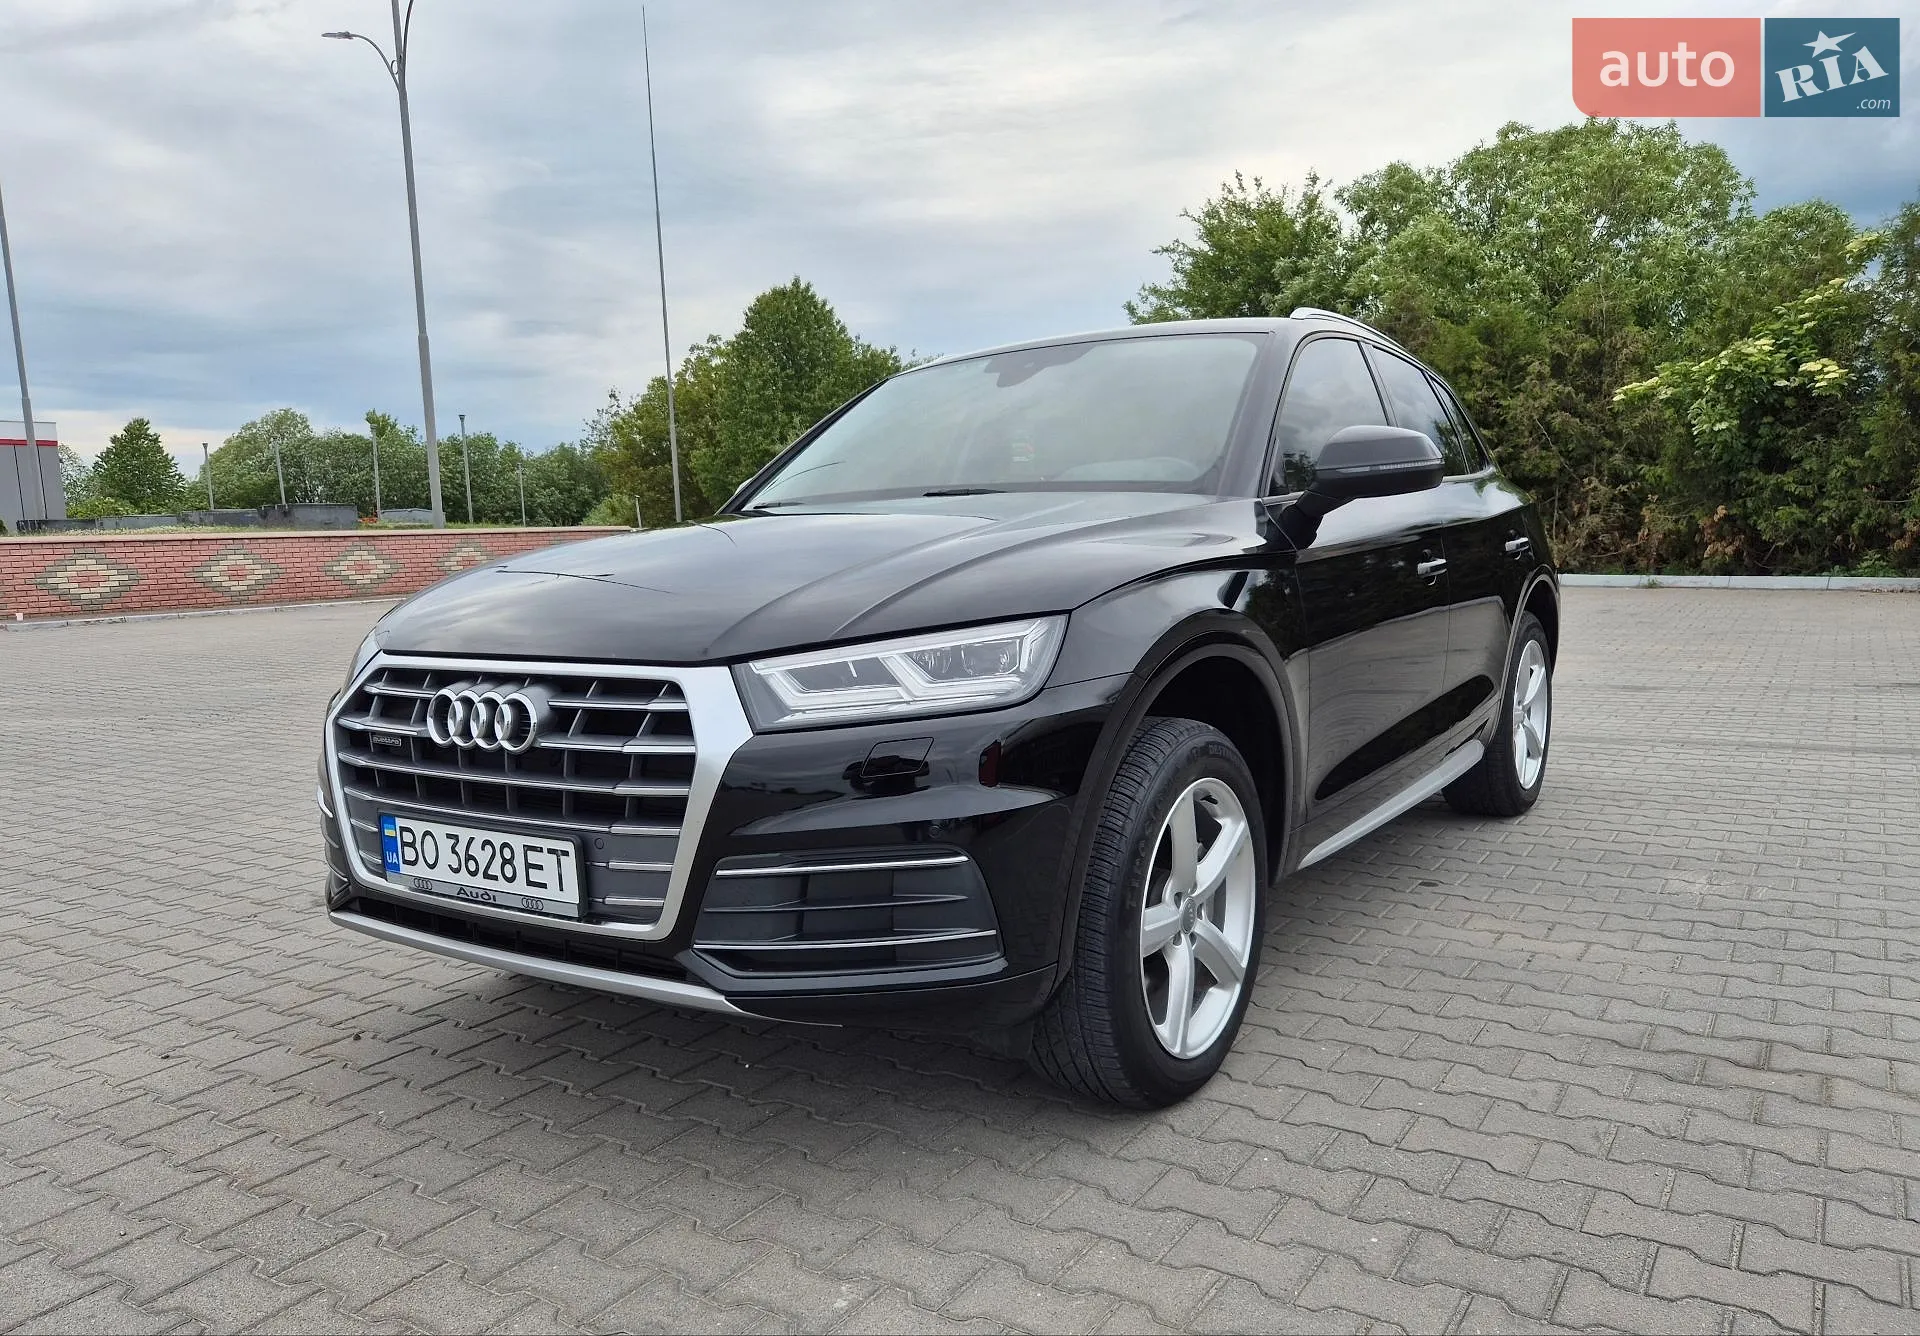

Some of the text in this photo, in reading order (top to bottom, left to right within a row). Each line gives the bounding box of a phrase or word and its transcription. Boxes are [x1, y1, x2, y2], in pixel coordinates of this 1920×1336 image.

[386, 853, 399, 865] UA
[399, 825, 569, 892] BO 3628 ET
[456, 886, 497, 902] Audi
